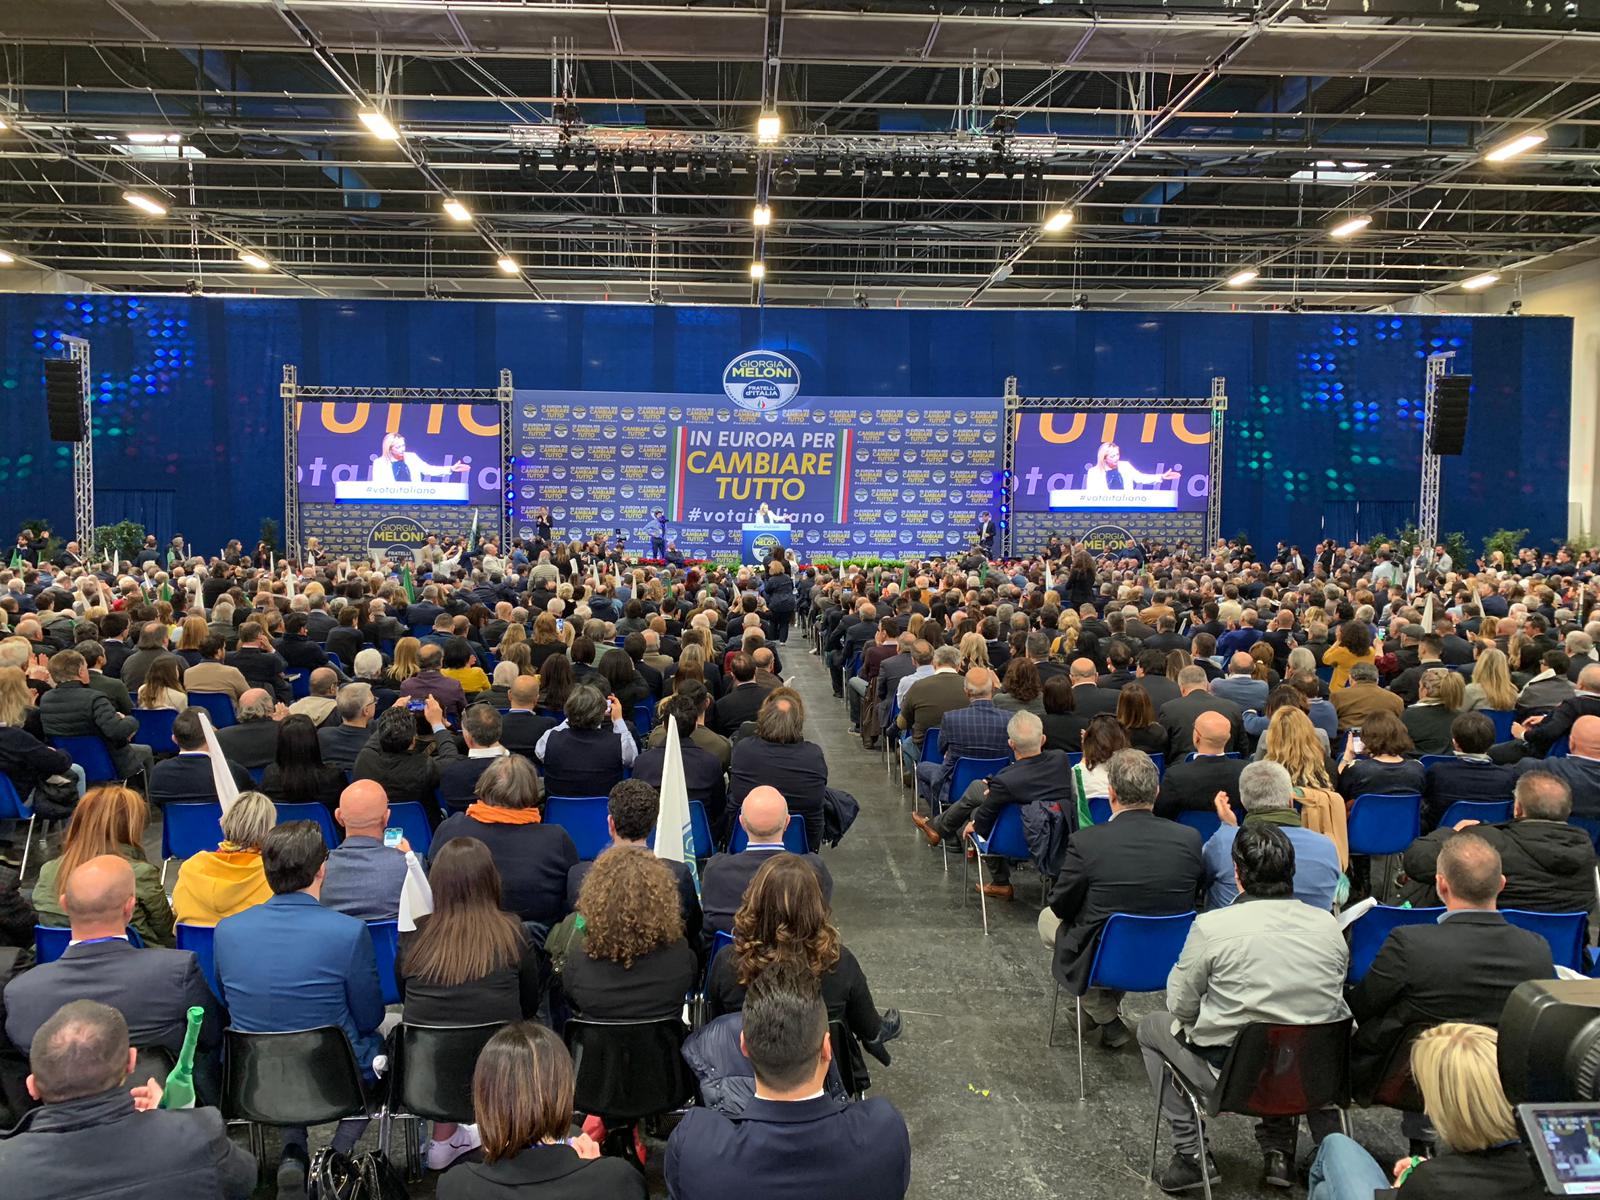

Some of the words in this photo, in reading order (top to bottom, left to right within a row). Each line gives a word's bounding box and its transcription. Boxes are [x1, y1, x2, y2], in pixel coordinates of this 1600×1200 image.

[740, 360, 784, 368] GIORGIA
[732, 368, 792, 378] MELONI
[689, 430, 712, 446] IN
[718, 431, 795, 448] EUROPA
[802, 432, 835, 449] PER
[687, 450, 833, 475] CAMBIARE
[366, 486, 436, 494] #votaitaliano
[715, 477, 805, 501] TUTTO
[1080, 494, 1147, 502] #votaitaliano
[374, 531, 424, 541] MELONI
[1084, 540, 1128, 549] MELON
